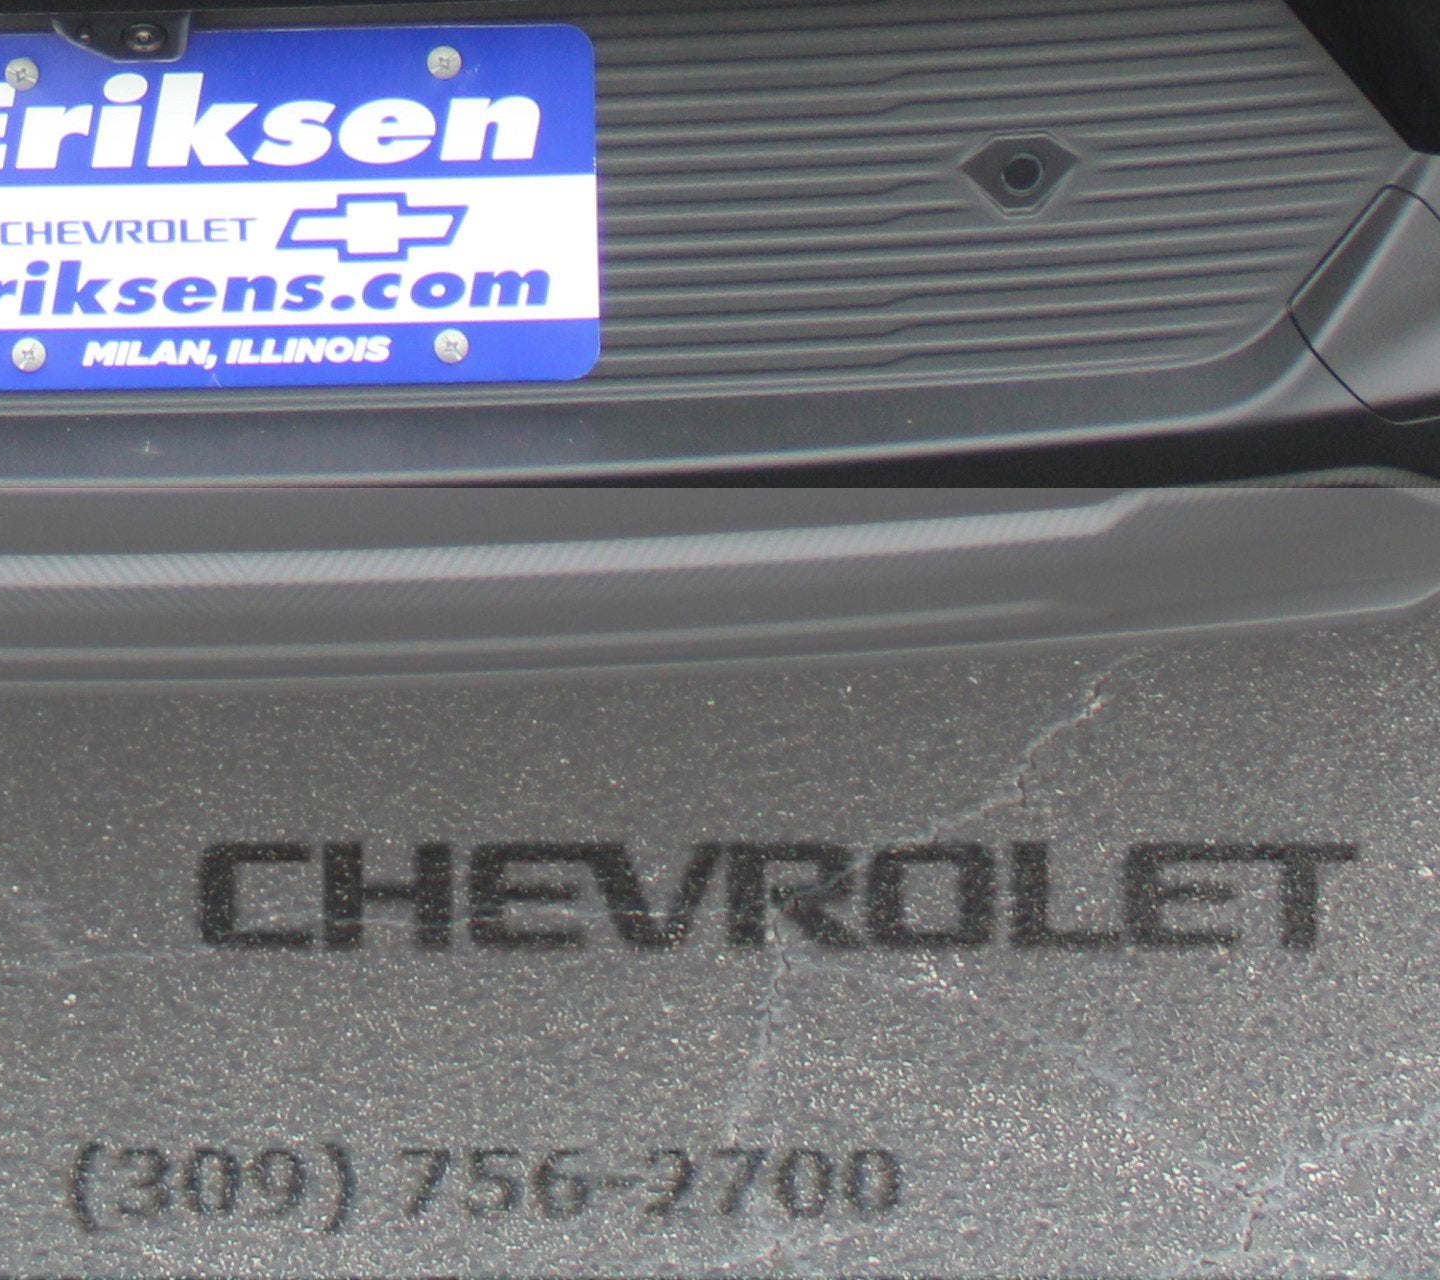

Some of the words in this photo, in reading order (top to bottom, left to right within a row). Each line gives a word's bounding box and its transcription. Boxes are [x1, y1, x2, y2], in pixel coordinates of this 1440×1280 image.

[0, 216, 257, 247] CHEVROLET
[82, 340, 219, 371] MILAN,
[226, 336, 392, 366] ILLINOIS
